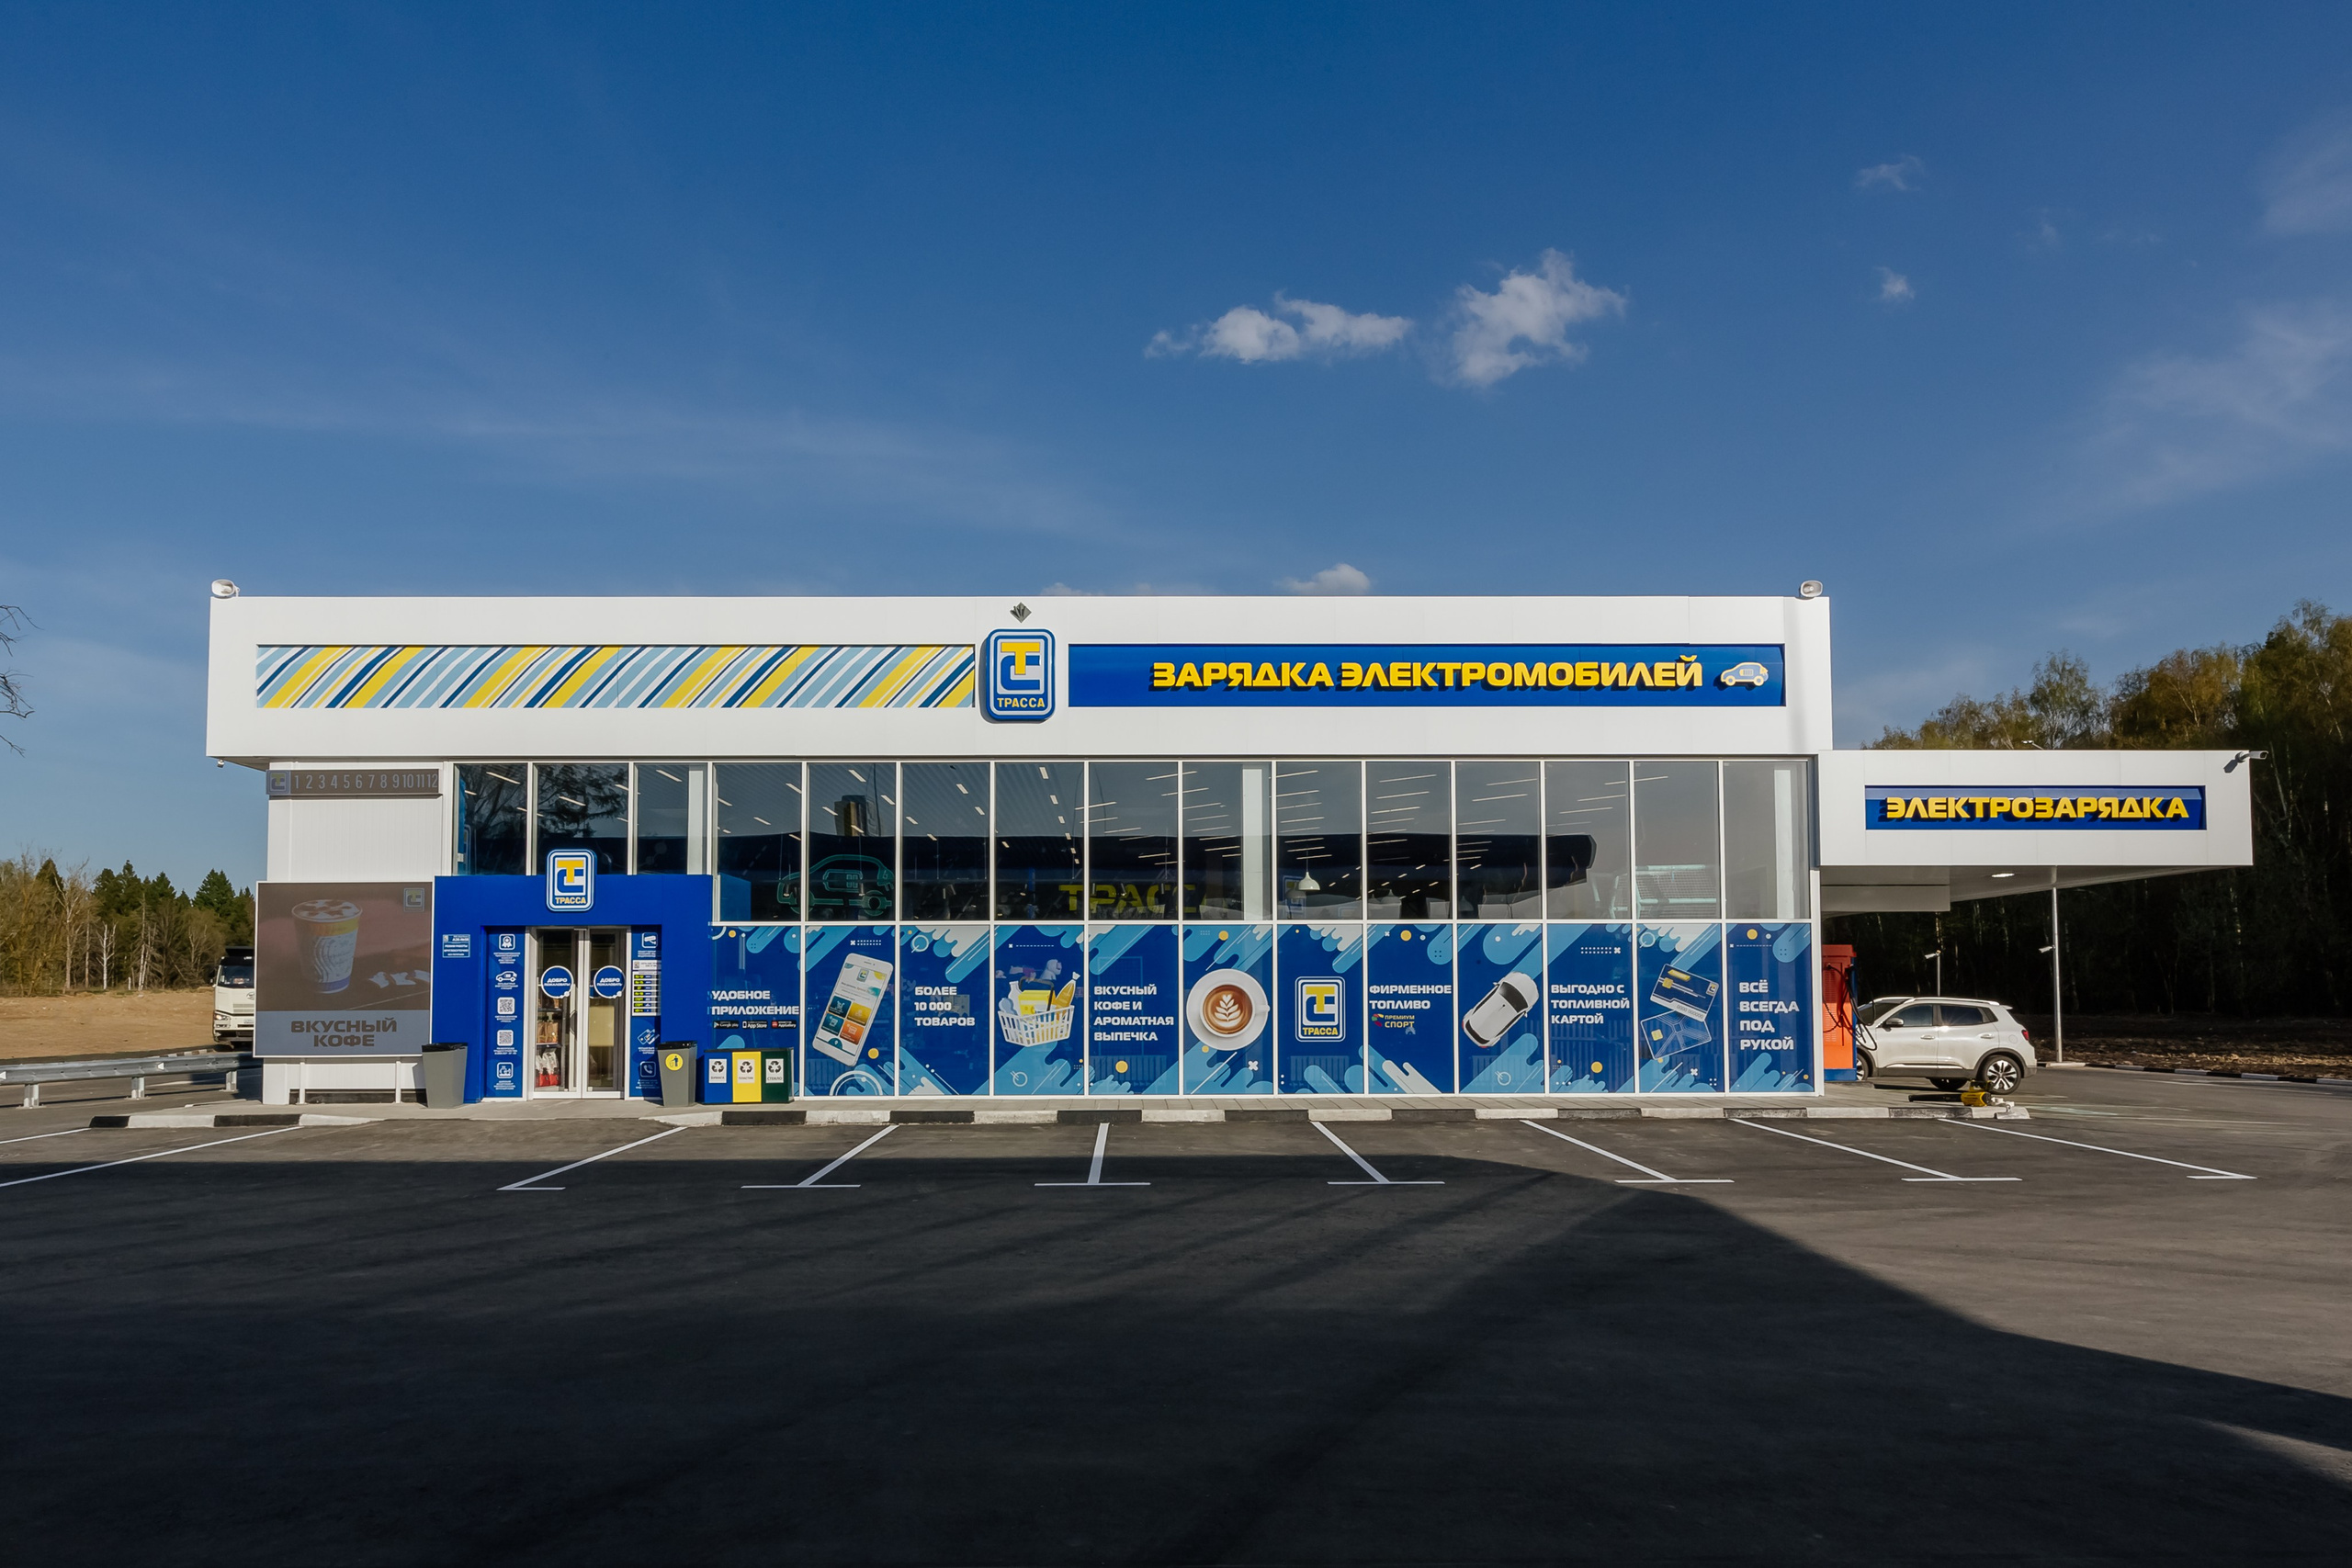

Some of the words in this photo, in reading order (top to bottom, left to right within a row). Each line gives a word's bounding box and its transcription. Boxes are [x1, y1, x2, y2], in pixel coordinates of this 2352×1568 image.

[1153, 661, 1334, 687] ЗАРЯДКА
[1341, 655, 1703, 687] ЭЛЕКТРОМОБИЛЕЙ
[997, 697, 1045, 708] ТРАССА
[1885, 796, 2190, 818] ЭЛЕКТРОЗАРЯДКА
[915, 987, 957, 996] БОЛЕЕ
[1093, 984, 1158, 996] ВКУСНЫЙ
[1369, 985, 1452, 995] ФИРМЕННОЕ
[1551, 984, 1615, 995] ВЫГОДНО
[1617, 984, 1624, 994] С
[1739, 979, 1769, 994] ВСЁ
[711, 990, 771, 1001] УДОБНОЕ
[914, 1001, 928, 1011] 10
[929, 1001, 952, 1011] 000
[1093, 1001, 1130, 1010] КОФЕ
[1132, 1001, 1142, 1010] И
[1369, 999, 1430, 1010] ТОПЛИВО
[1551, 997, 1630, 1010] ТОПЛИВНОЙ
[1739, 1001, 1800, 1013] ВСЕГДА
[711, 1006, 799, 1015] ПРИЛОЖЕНИЕ
[914, 1017, 976, 1026] ТОВАРОВ
[1093, 1016, 1174, 1026] АРОМАТНАЯ
[1551, 1013, 1604, 1024] КАРТОЙ
[291, 1017, 397, 1033] ВКУСНЫЙ
[1739, 1020, 1775, 1032] ПОД
[1093, 1032, 1158, 1041] ВЫПЕЧКА
[1302, 1027, 1339, 1035] ТРАССА
[313, 1034, 375, 1047] КОФЕ
[1740, 1036, 1794, 1050] РУКОЙ
